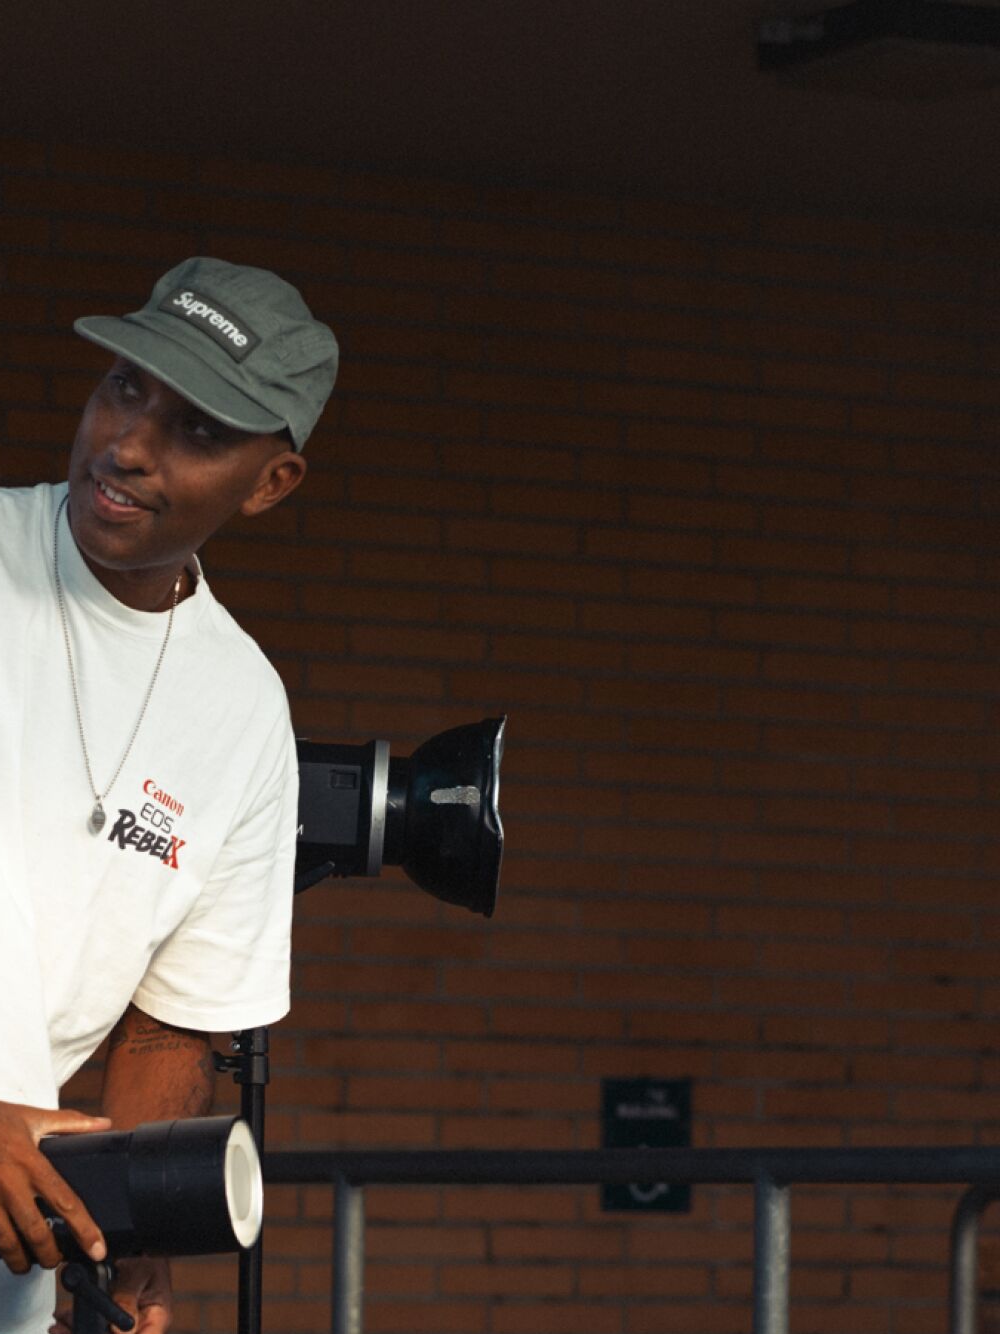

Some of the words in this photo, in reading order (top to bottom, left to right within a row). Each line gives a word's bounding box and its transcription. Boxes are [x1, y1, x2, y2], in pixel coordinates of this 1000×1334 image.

[173, 292, 248, 347] Supreme
[143, 779, 184, 817] Canon
[140, 802, 174, 834] EOS
